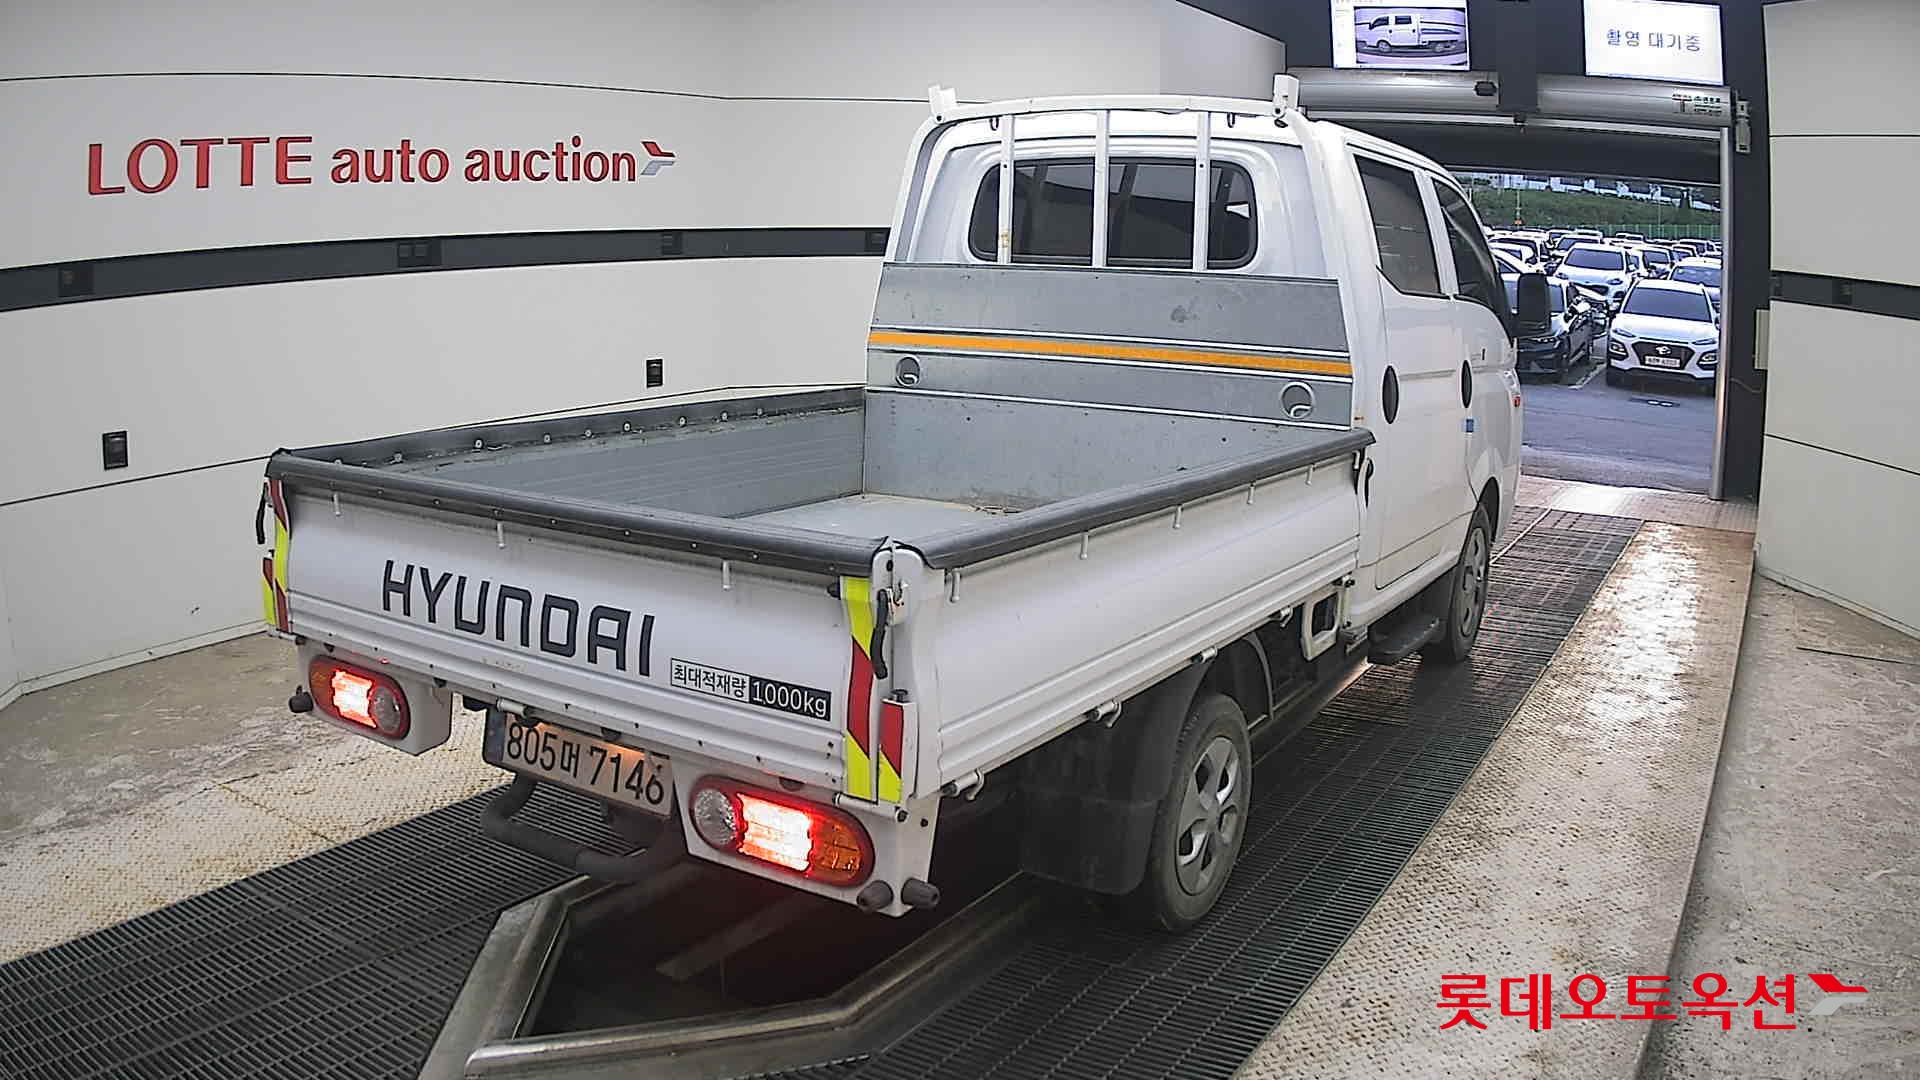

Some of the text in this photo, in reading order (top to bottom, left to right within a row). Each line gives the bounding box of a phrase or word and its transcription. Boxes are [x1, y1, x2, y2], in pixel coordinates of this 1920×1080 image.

[1648, 31, 1701, 52] 대기중
[88, 135, 637, 195] LOTTE auto auction
[382, 559, 656, 677] HYUNDAI
[673, 664, 746, 699] 최대적재량
[507, 722, 664, 805] 805머 7146
